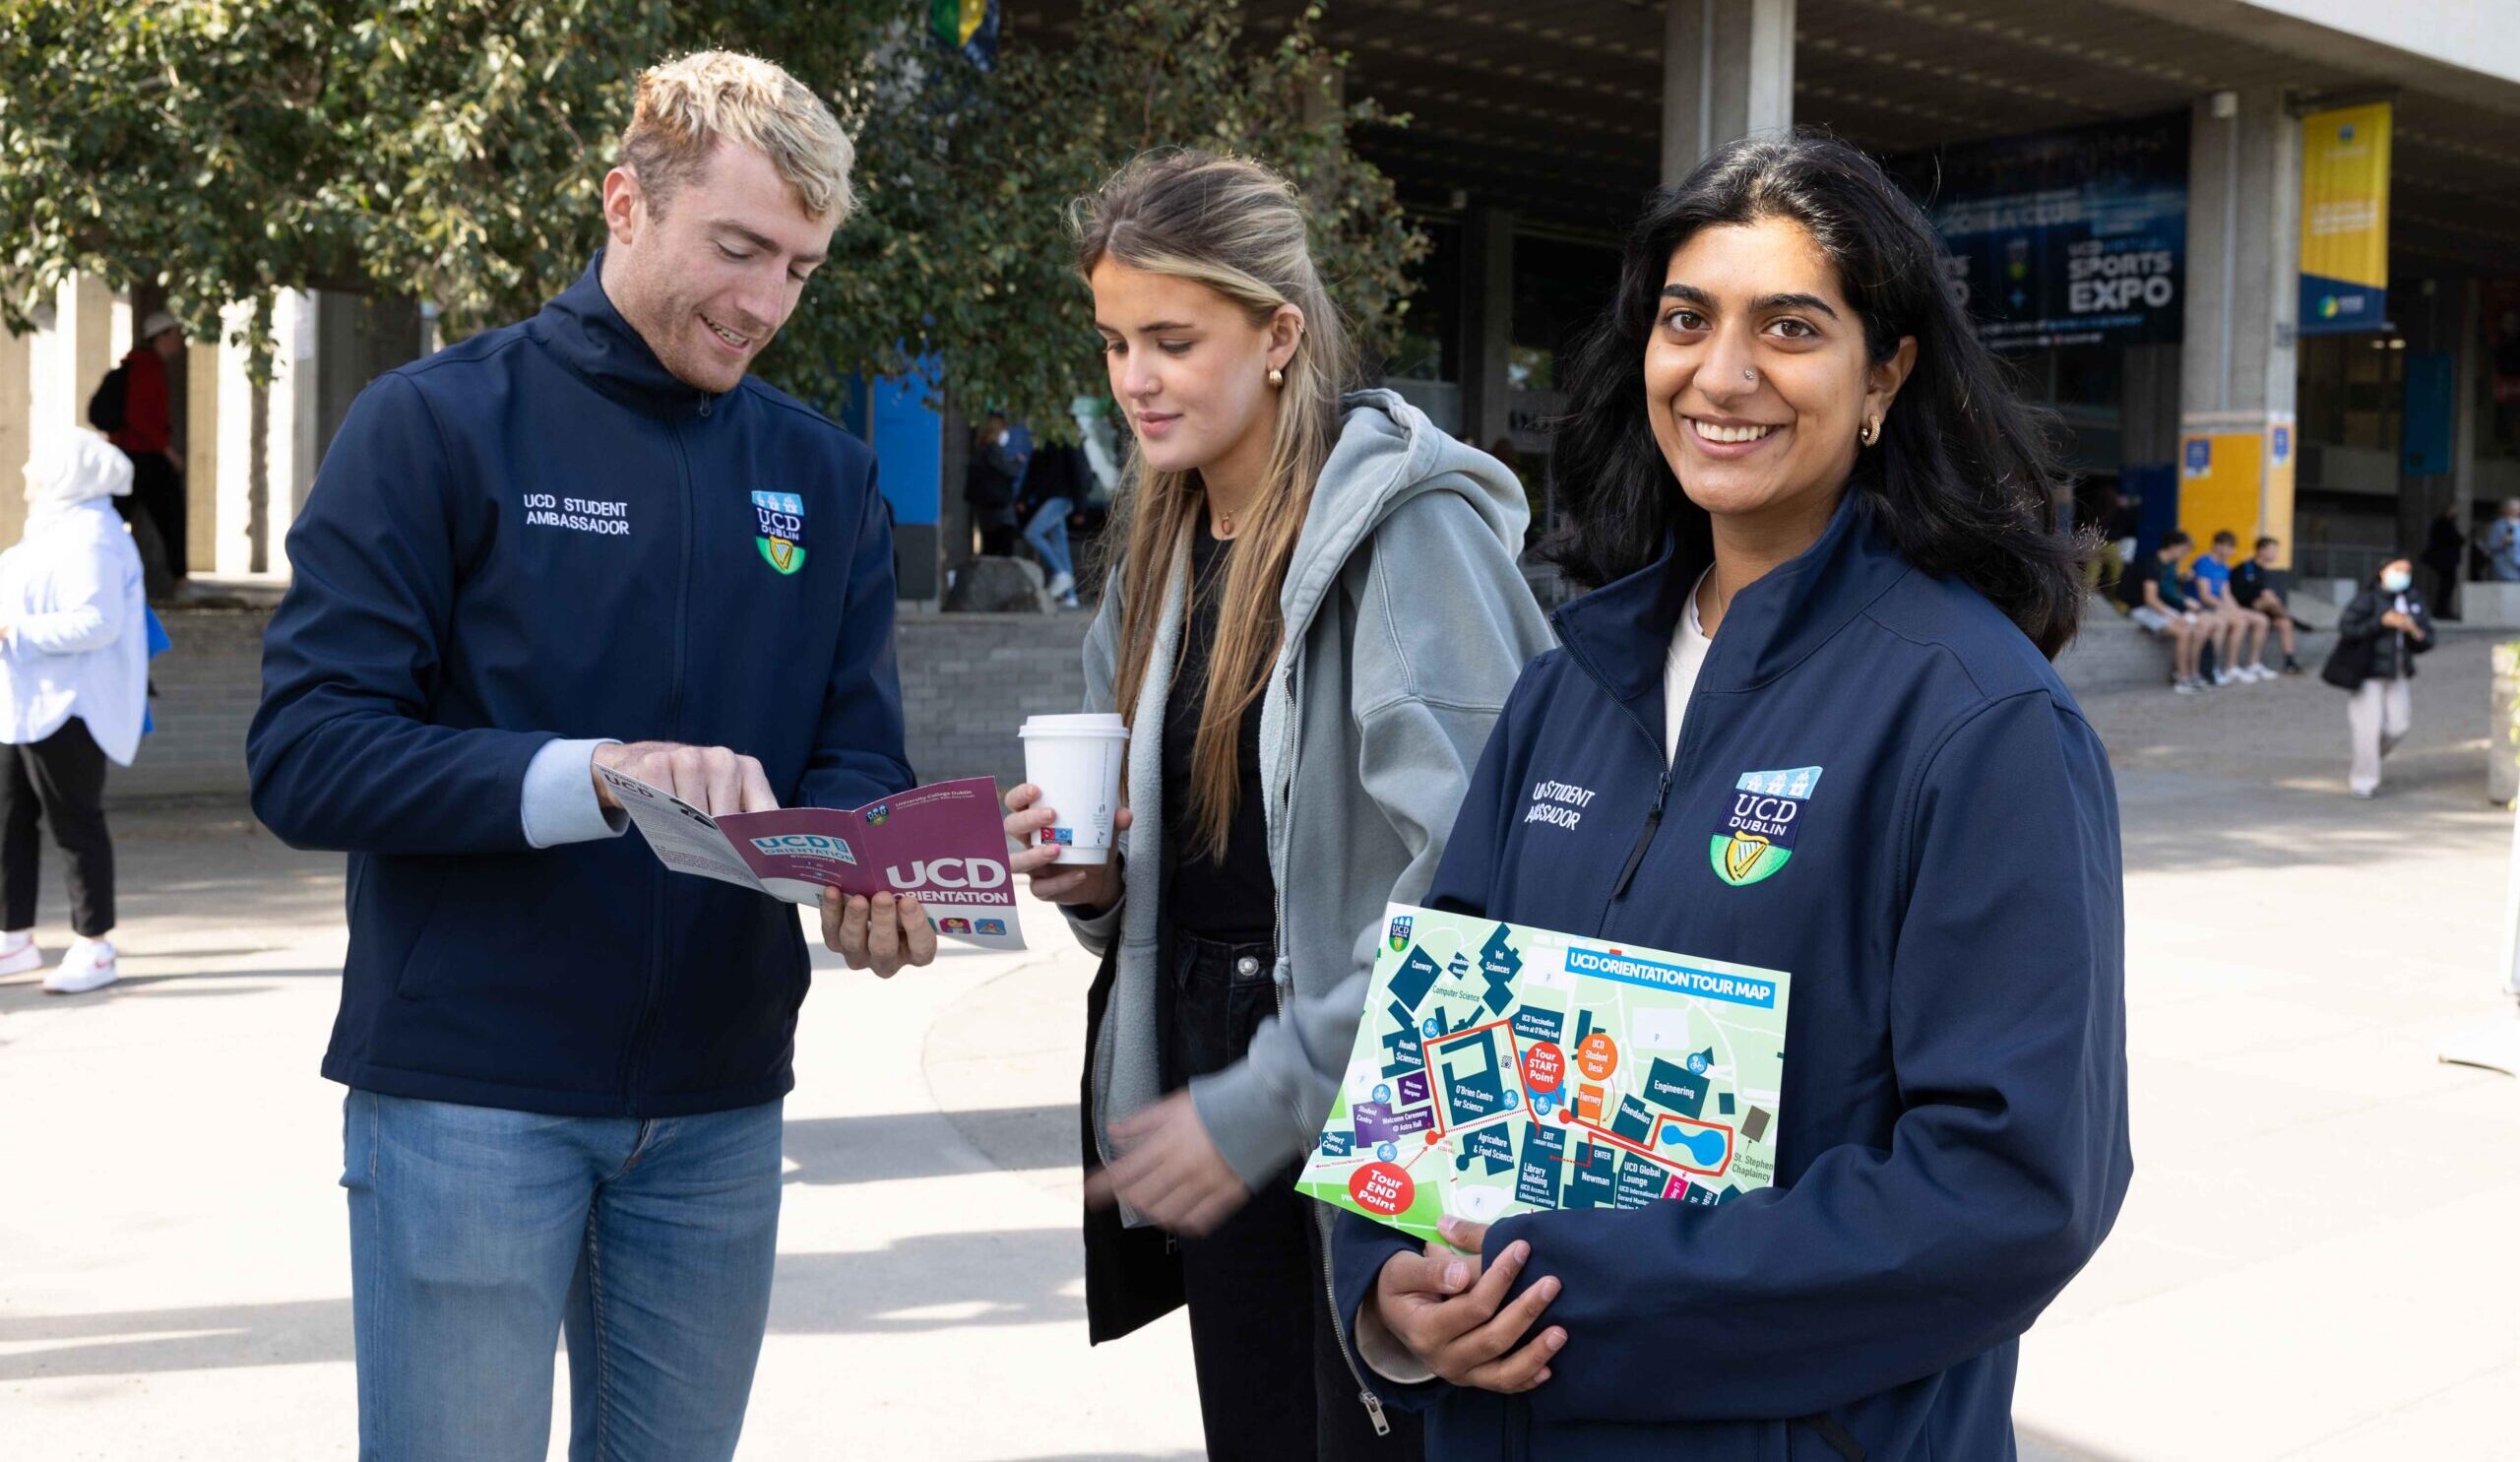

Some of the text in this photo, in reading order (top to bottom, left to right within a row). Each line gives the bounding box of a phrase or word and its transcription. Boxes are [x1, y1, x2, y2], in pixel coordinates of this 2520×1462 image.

[2068, 250, 2173, 282] SPORTS
[2068, 276, 2174, 313] EXPO
[524, 494, 628, 517] UCD STUDENT
[526, 511, 630, 535] AMBASSADOR
[756, 507, 801, 533] UCD
[760, 524, 800, 540] DUBLIN
[603, 773, 655, 798] UCD
[1544, 780, 1596, 807] STUDENT
[1733, 793, 1797, 823] UCD
[1729, 815, 1788, 836] DUBLIN
[755, 836, 831, 849] UCD
[765, 848, 854, 862] ORIENTATION
[886, 858, 1007, 889] UCD
[1392, 924, 1410, 934] UCD
[1412, 959, 1433, 974] Conway
[1485, 961, 1510, 975] Sciences
[1570, 952, 1771, 1001] UCD ORIENTATION TOUR MAP
[1432, 985, 1480, 1002] Computer Science
[1515, 1022, 1530, 1032] Centre
[1521, 1014, 1555, 1028] UCD Vaccination
[1398, 1040, 1418, 1051] Health
[1592, 1039, 1606, 1049] UCD
[1396, 1051, 1422, 1065] Sciences
[1535, 1048, 1556, 1060] Tour
[1585, 1050, 1608, 1063] Student
[1529, 1058, 1559, 1073] START
[1588, 1063, 1604, 1074] Desk
[1530, 1071, 1554, 1084] Point
[1455, 1084, 1494, 1103] O'Brien Centre
[1654, 1079, 1695, 1100] Engineering
[1453, 1098, 1484, 1113] for Science
[1579, 1091, 1603, 1107] Tierney
[1357, 1106, 1377, 1116] Student
[1382, 1110, 1428, 1125] Welcome Ceremony
[1621, 1103, 1651, 1124] Daedalus
[1355, 1114, 1373, 1124] Centre
[1326, 1132, 1345, 1145] Sport
[1478, 1132, 1508, 1148] Agriculture
[1543, 1131, 1555, 1141] EXIT
[1322, 1140, 1344, 1155] Centre
[1479, 1146, 1491, 1158] Food
[1491, 1150, 1513, 1164] Science
[1594, 1149, 1611, 1161] ENTER
[1523, 1162, 1546, 1176] Library
[1623, 1161, 1662, 1177] UCD Global
[1733, 1152, 1774, 1172] St. Stephen
[1371, 1170, 1403, 1189] Tour
[1522, 1171, 1548, 1188] Building
[1581, 1171, 1610, 1186] Newman
[1622, 1173, 1649, 1187] Lounge
[1732, 1164, 1771, 1183] Chaplaincy
[1365, 1181, 1397, 1199] END
[1519, 1191, 1536, 1204] Lifelong
[1629, 1186, 1660, 1200] International)
[1357, 1189, 1396, 1212] Point
